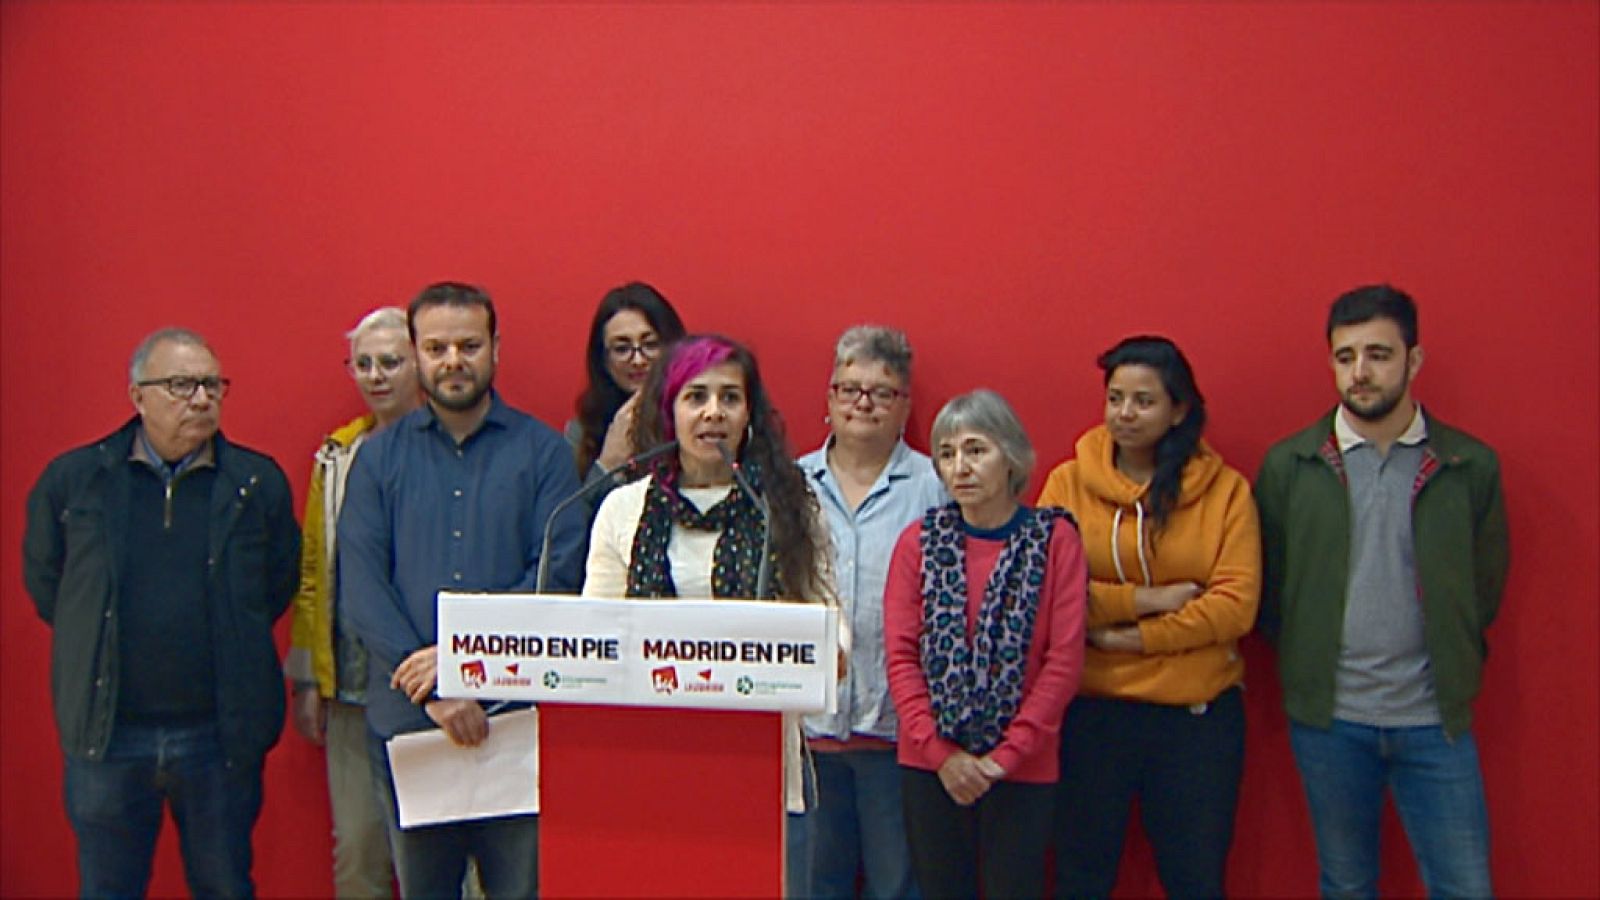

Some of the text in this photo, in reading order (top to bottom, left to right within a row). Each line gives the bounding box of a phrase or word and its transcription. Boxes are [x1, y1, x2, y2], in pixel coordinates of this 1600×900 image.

[452, 634, 619, 660] MADRID EN PIE
[643, 639, 815, 664] MADRID EN PIE
